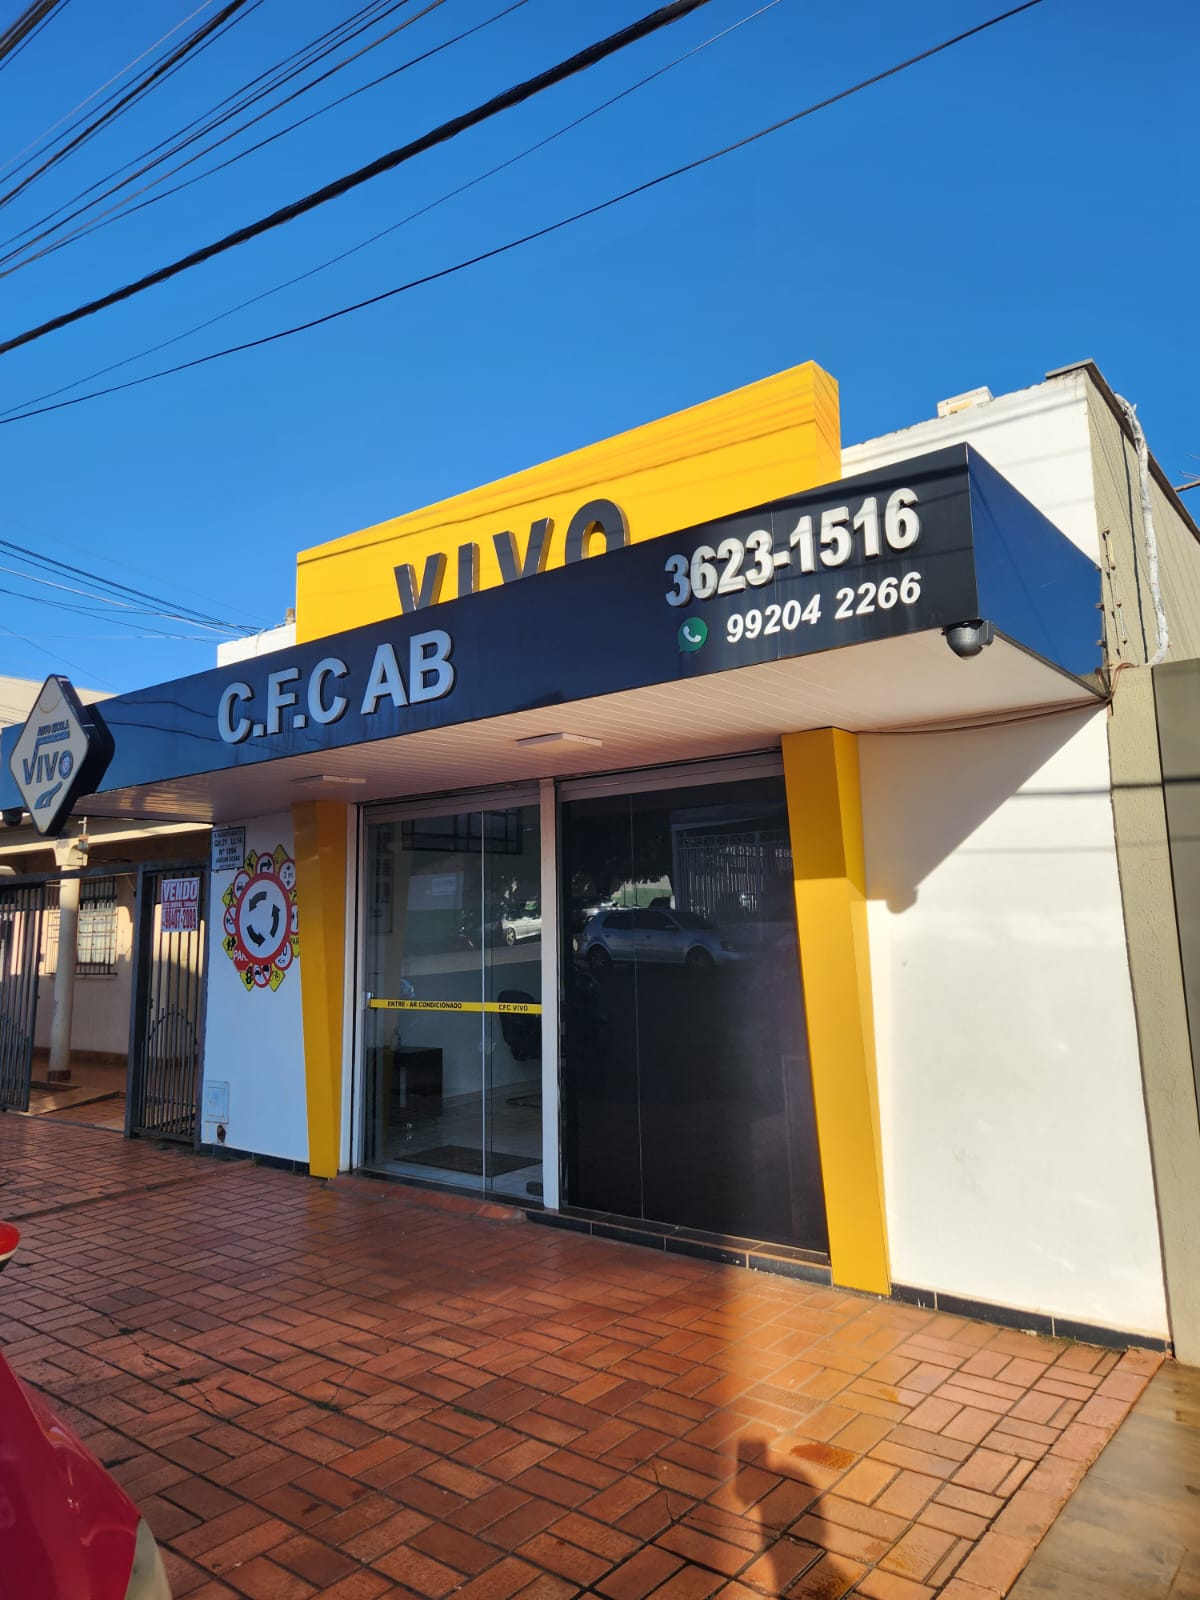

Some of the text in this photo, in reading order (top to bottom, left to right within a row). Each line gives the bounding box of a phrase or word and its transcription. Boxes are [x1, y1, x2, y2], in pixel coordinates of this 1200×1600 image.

[665, 488, 921, 607] 3623-1516
[727, 571, 922, 643] 99204 2266
[360, 630, 455, 715] AB
[22, 750, 74, 785] VIVO
[162, 880, 198, 901] VENDO
[418, 1001, 463, 1009] CONDICIONADO
[512, 1004, 529, 1012] VIVO
